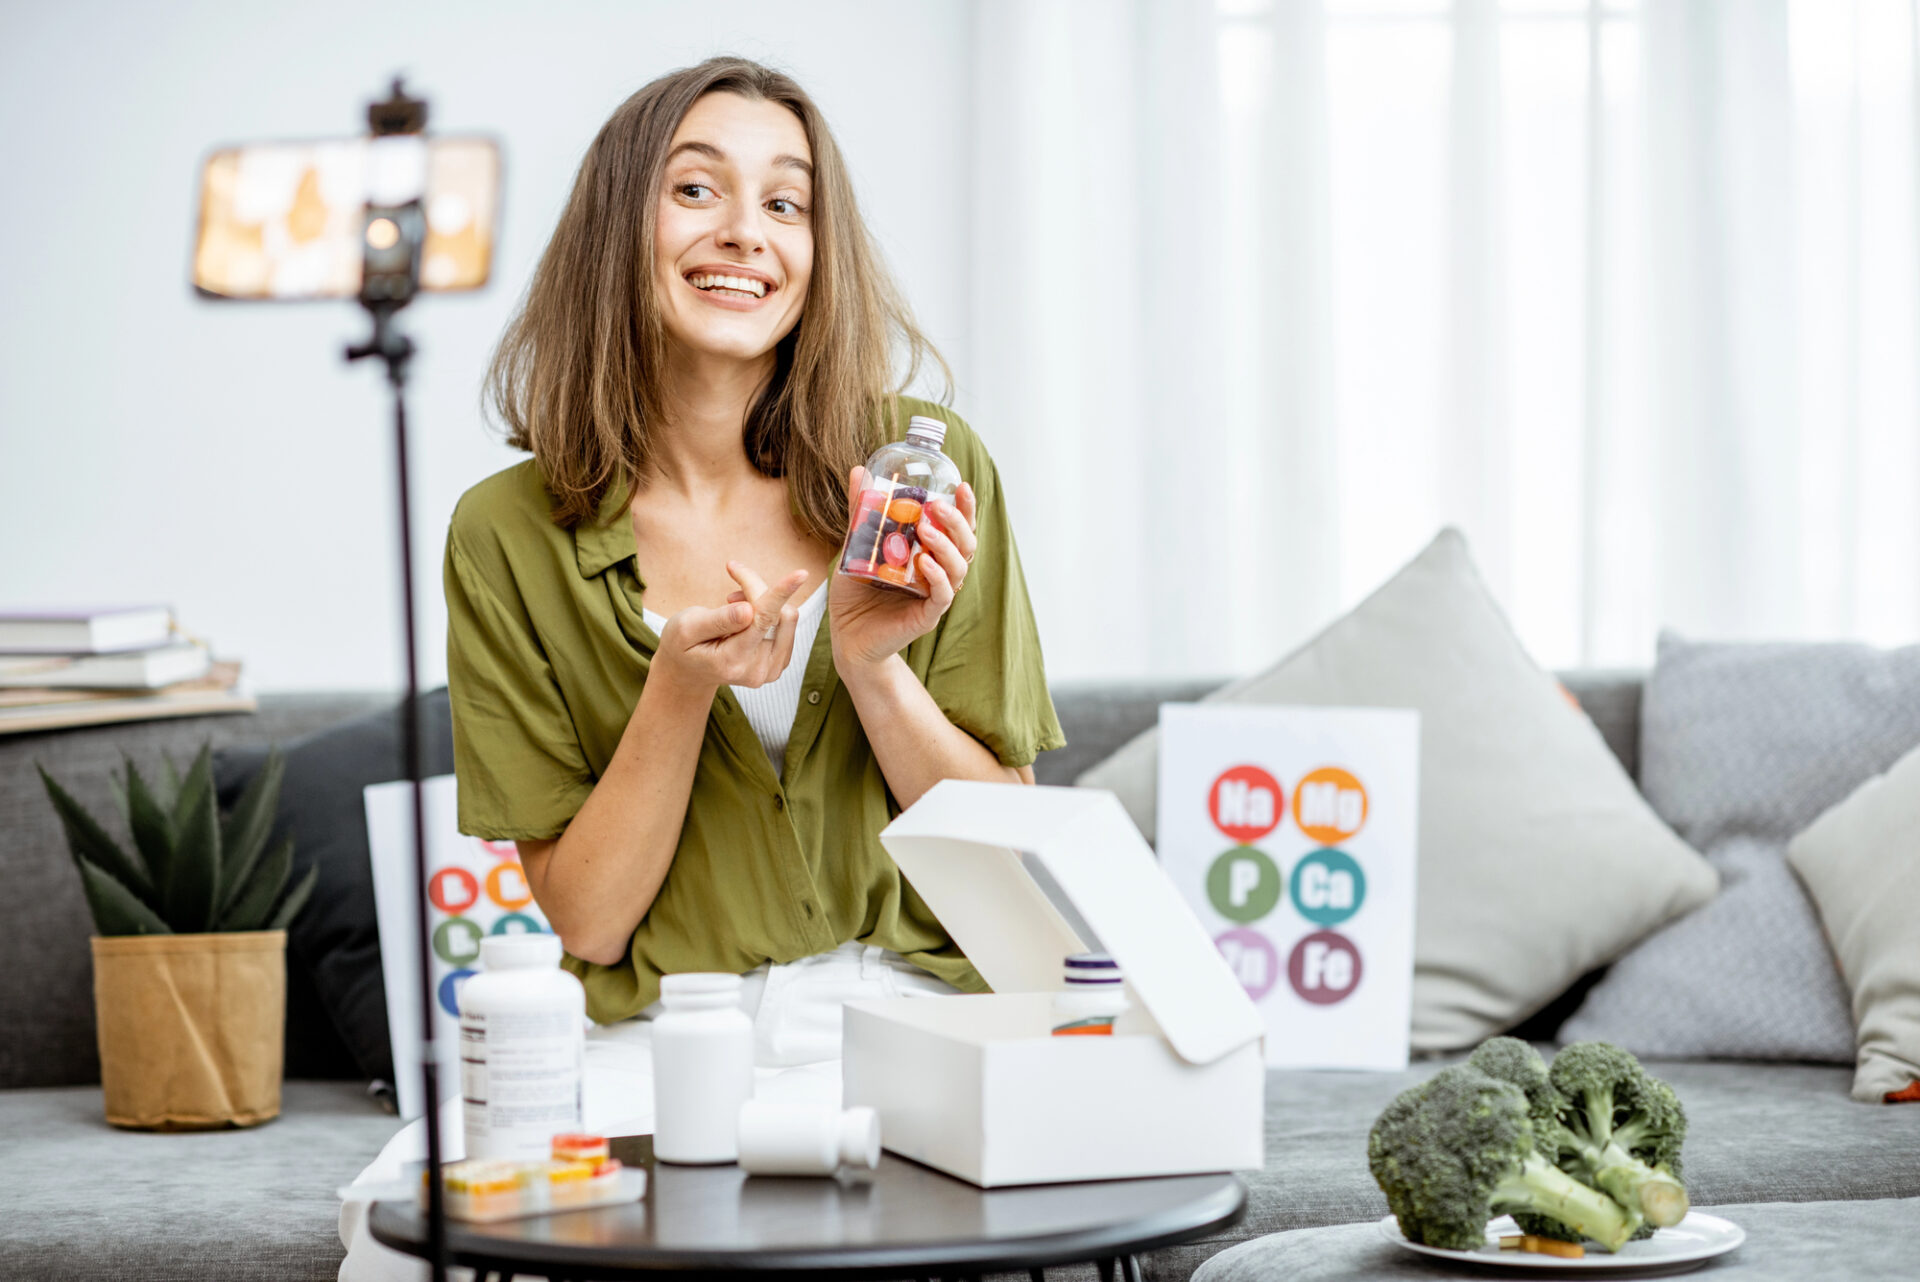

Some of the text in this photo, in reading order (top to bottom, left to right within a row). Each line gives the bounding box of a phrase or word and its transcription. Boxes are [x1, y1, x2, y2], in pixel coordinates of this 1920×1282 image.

[1218, 779, 1274, 828] Na
[1301, 781, 1363, 834] Mg
[1229, 858, 1260, 908] P
[1300, 862, 1355, 910] Ca
[1302, 941, 1353, 991] Fe
